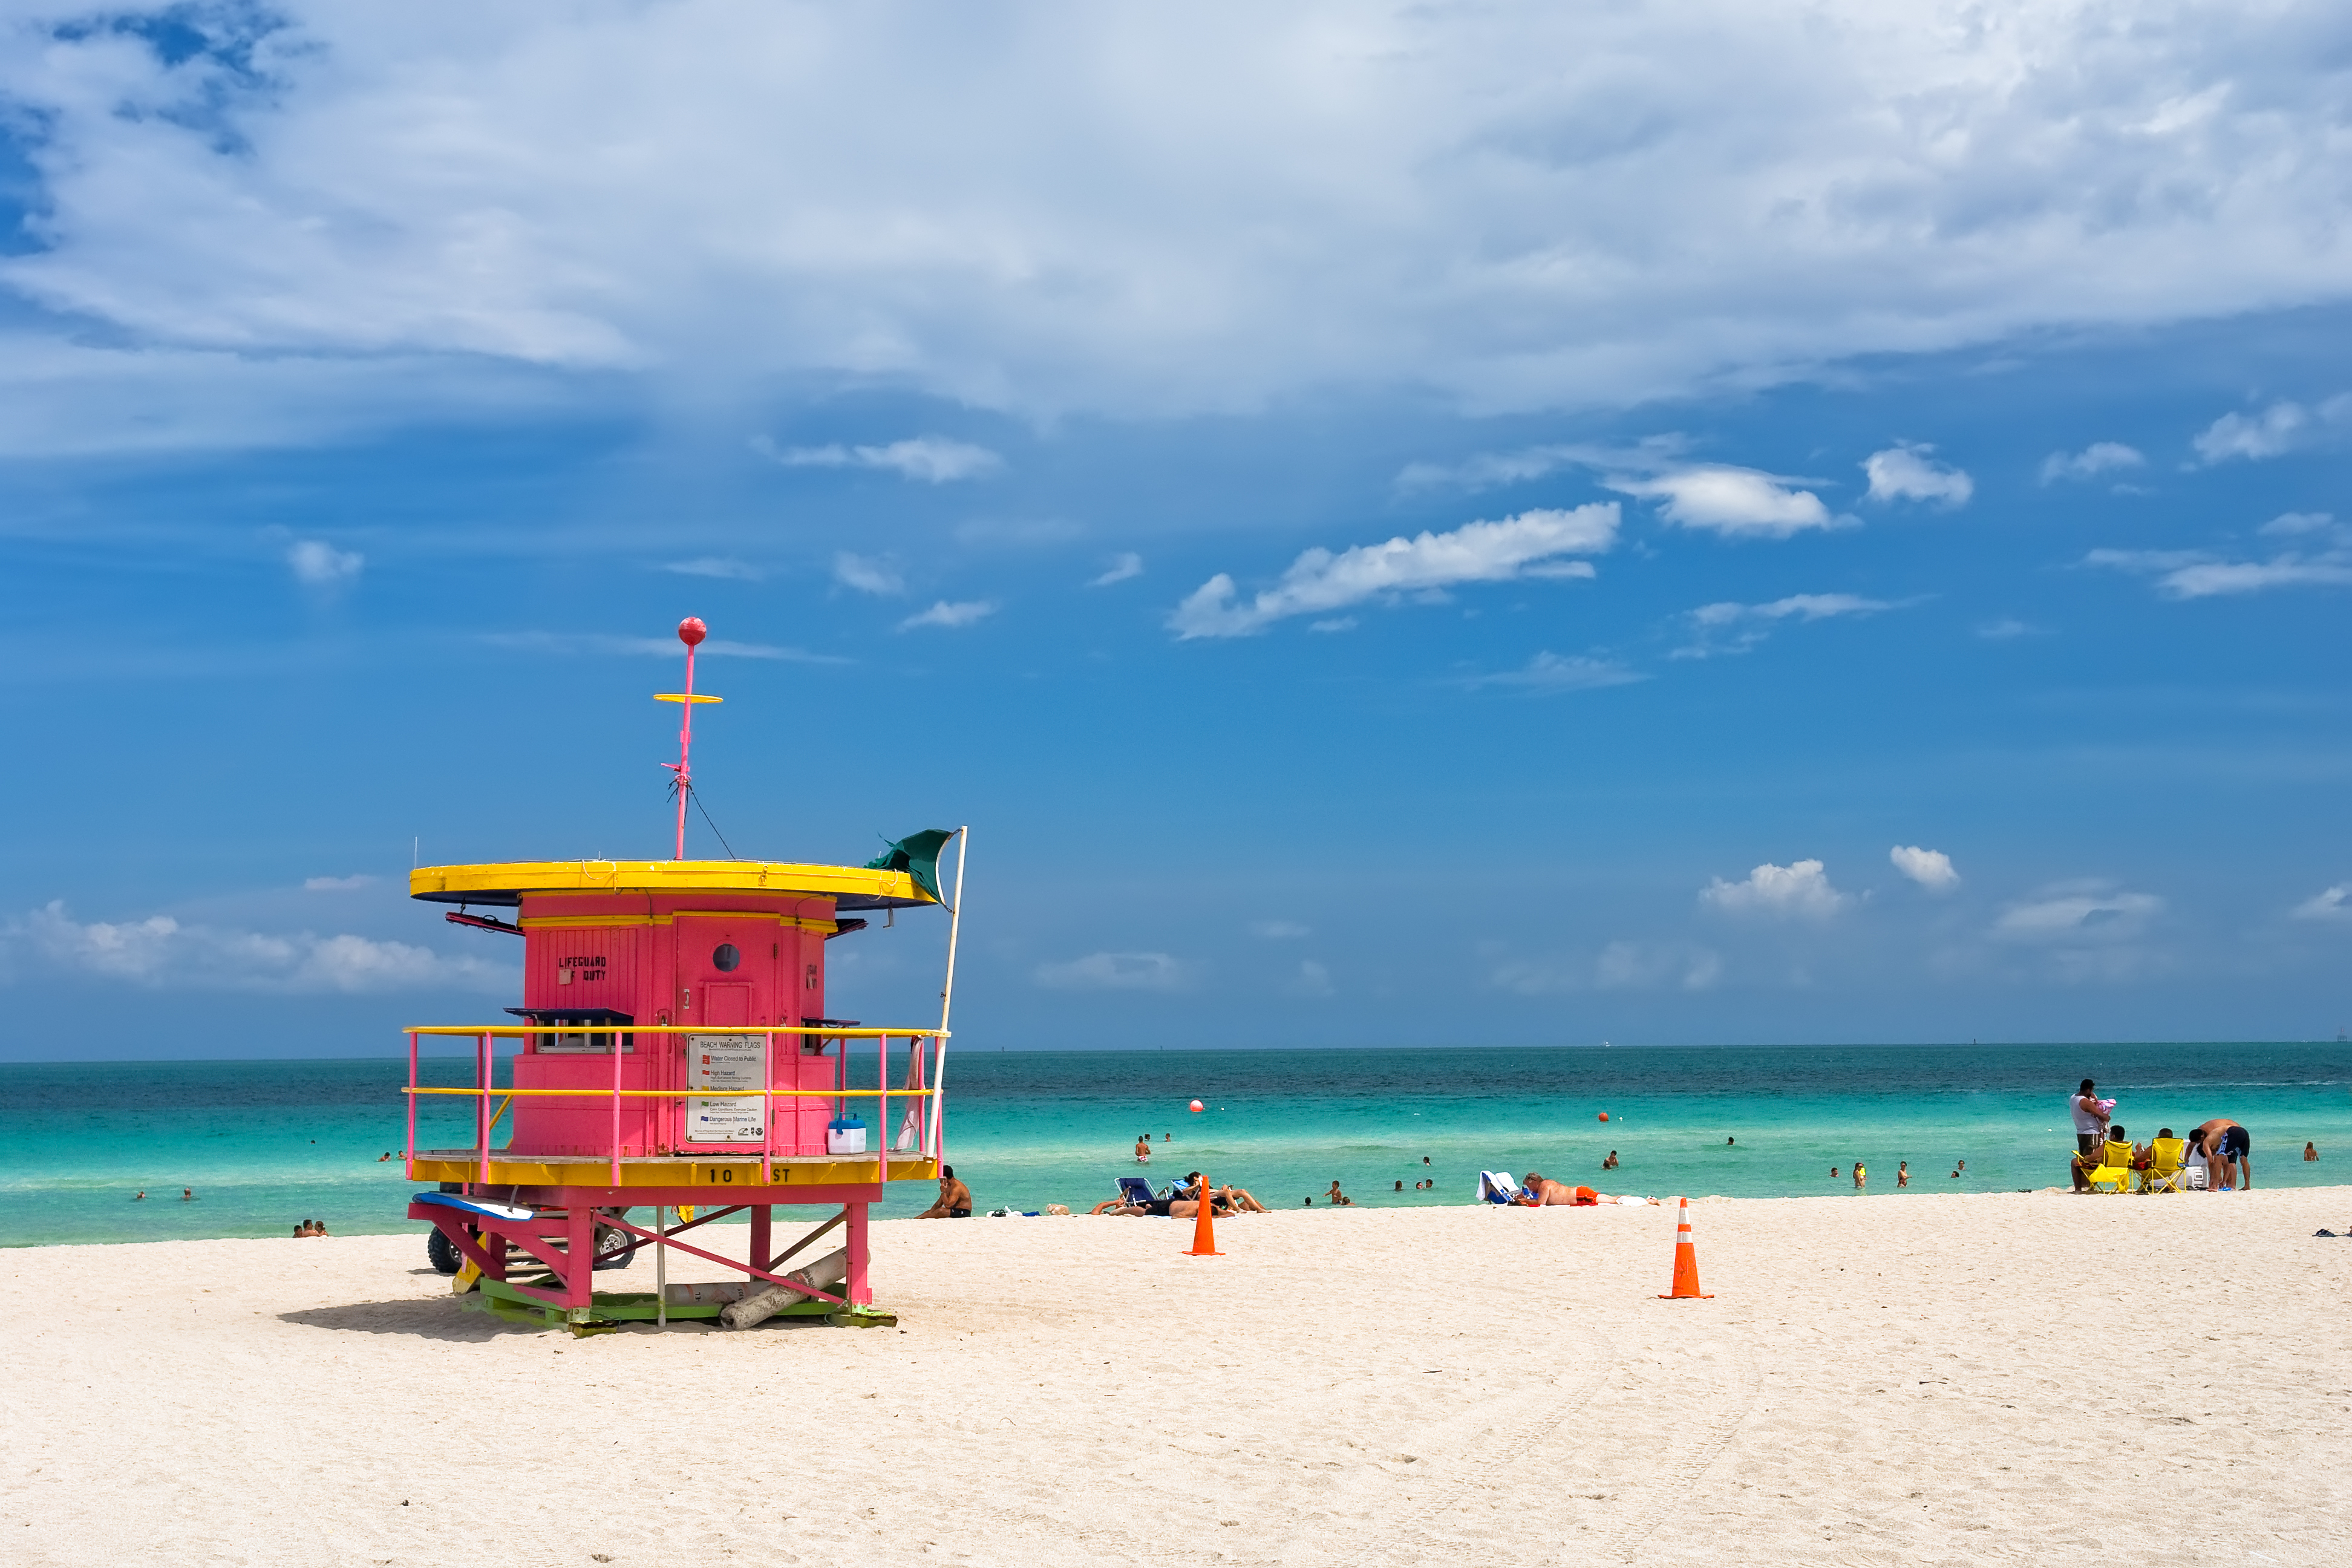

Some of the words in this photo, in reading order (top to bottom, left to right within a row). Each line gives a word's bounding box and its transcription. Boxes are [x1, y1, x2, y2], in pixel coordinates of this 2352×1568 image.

[559, 956, 606, 967] LIFEGUARD
[583, 970, 606, 981] DUTY
[710, 1169, 732, 1183] 10
[773, 1169, 790, 1182] ST
